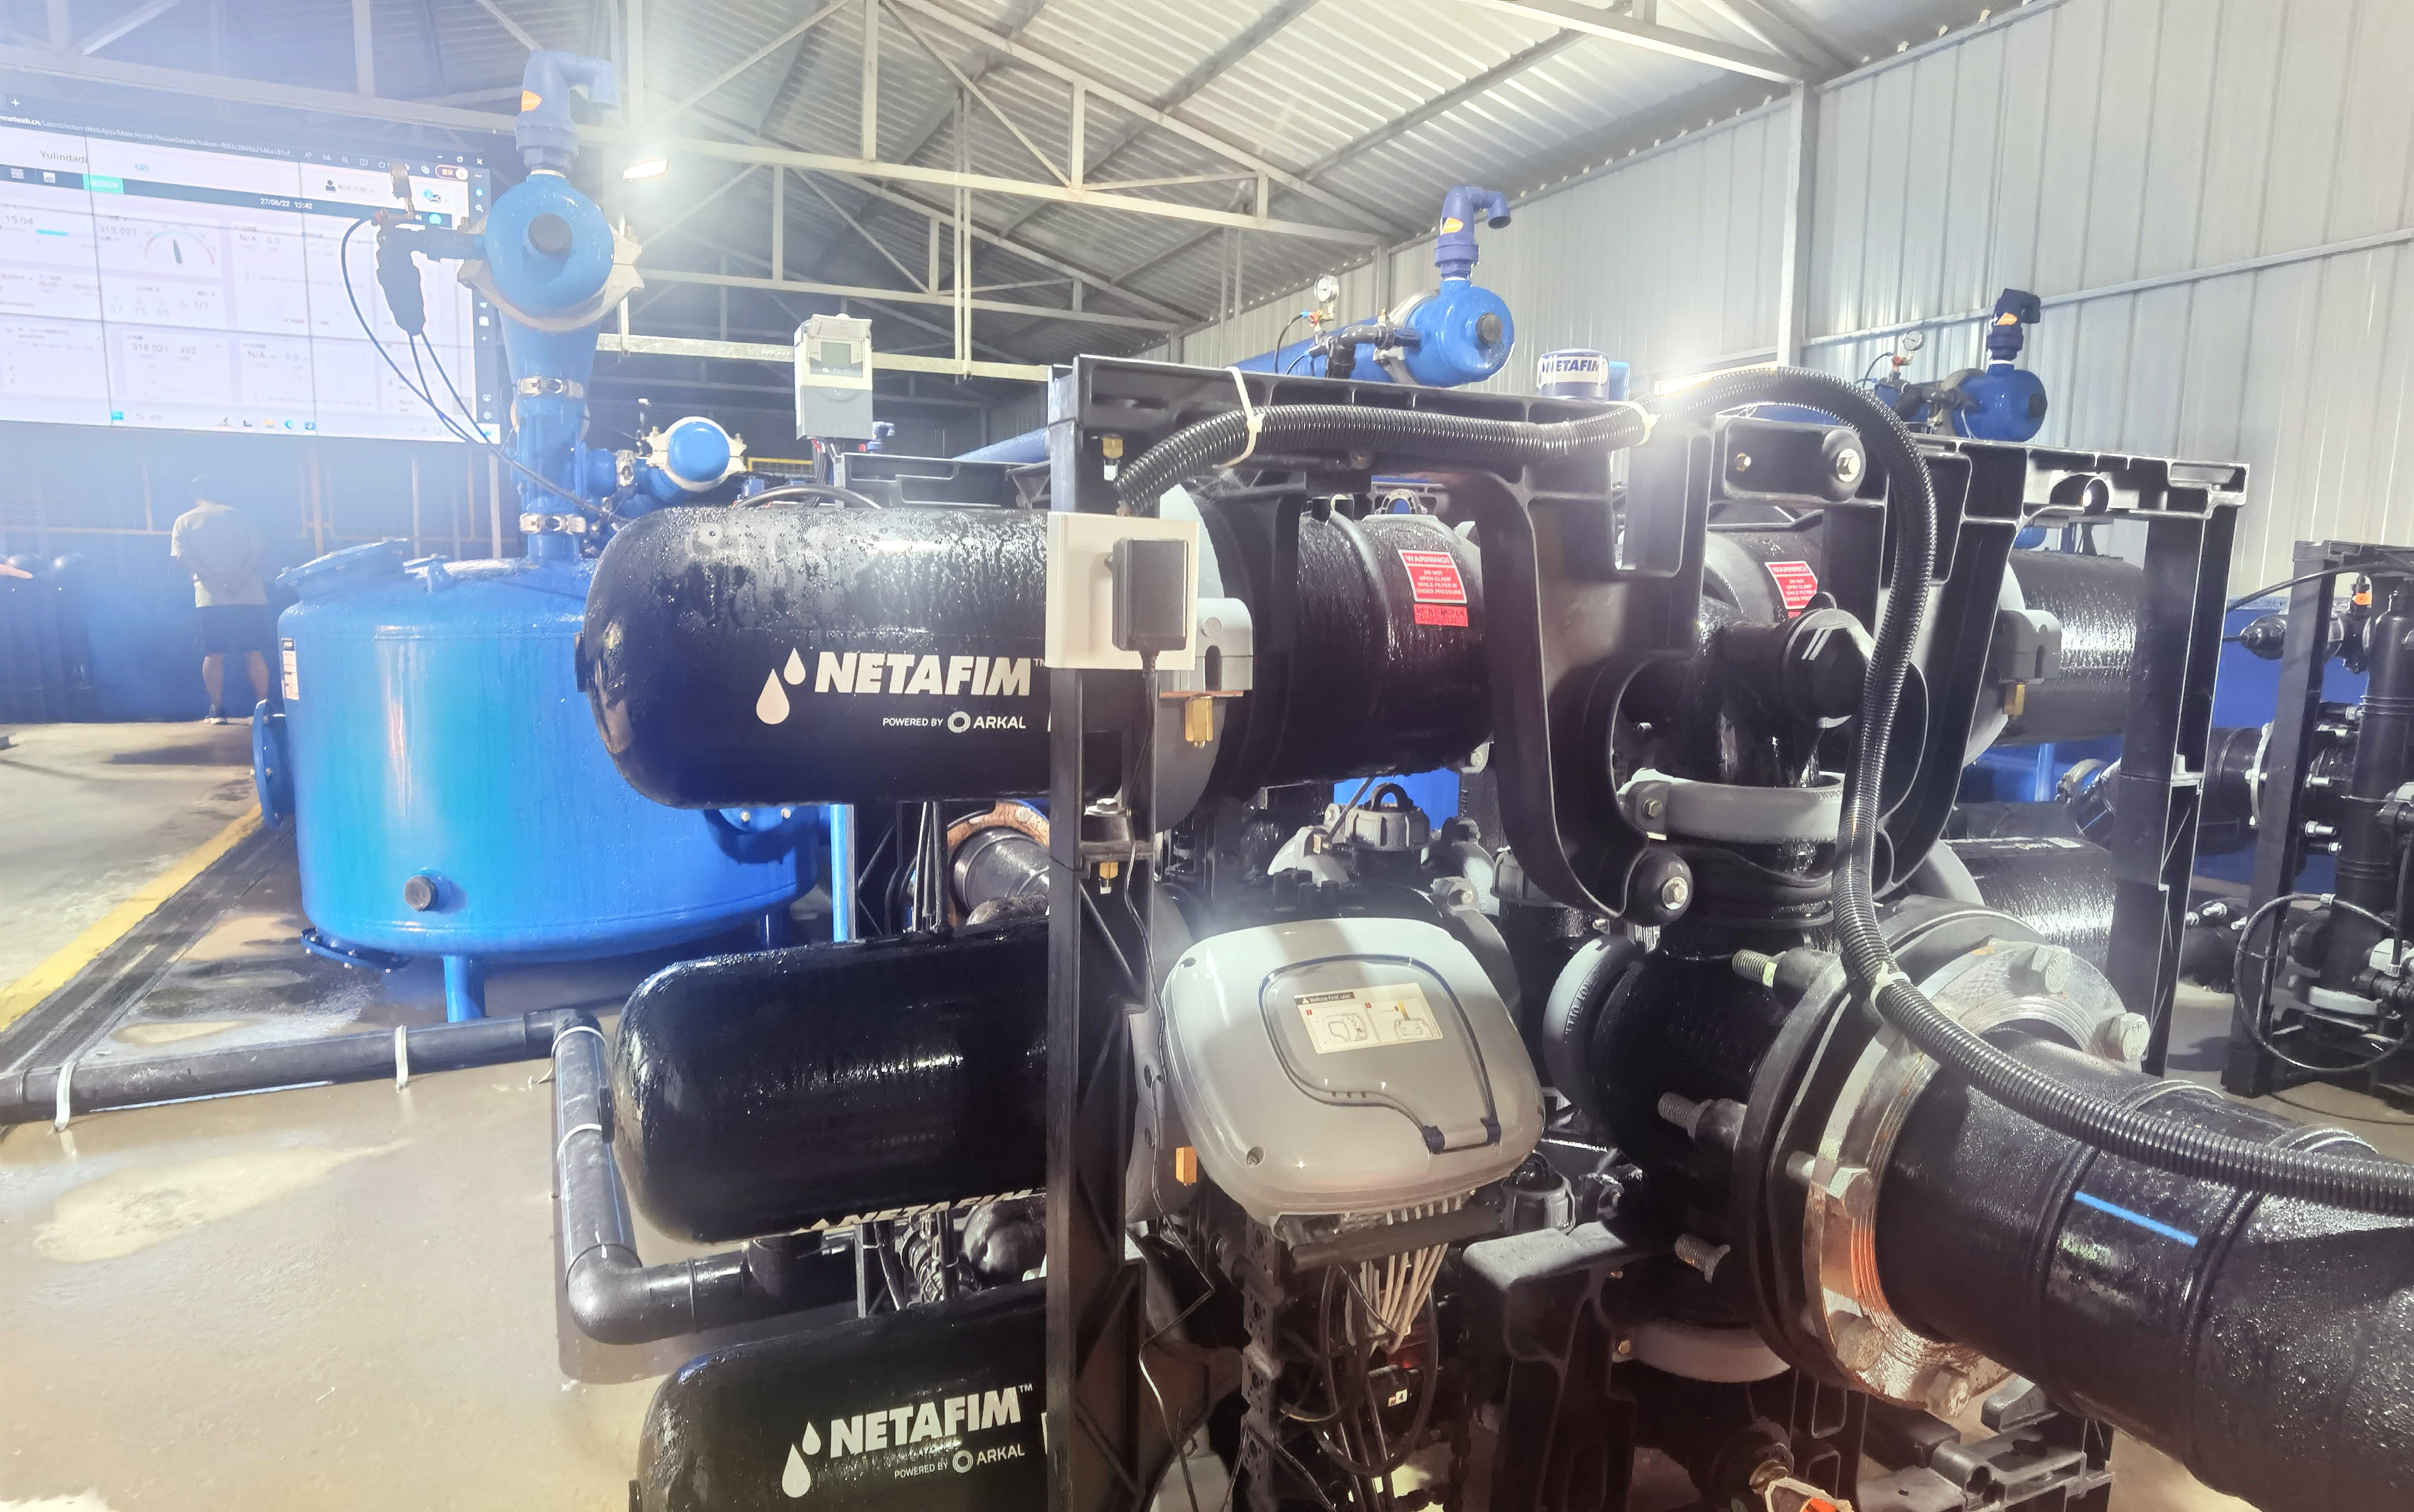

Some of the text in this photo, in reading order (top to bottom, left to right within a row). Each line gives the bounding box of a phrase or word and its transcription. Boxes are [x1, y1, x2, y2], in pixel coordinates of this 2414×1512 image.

[1404, 554, 1452, 565] WARNING!
[815, 651, 1031, 696] NETAFIM
[883, 715, 1027, 730] POWERED BY ARKAL
[830, 1386, 1022, 1459] NETAFIM
[894, 1443, 1025, 1479] POWERED BY ARKAL
